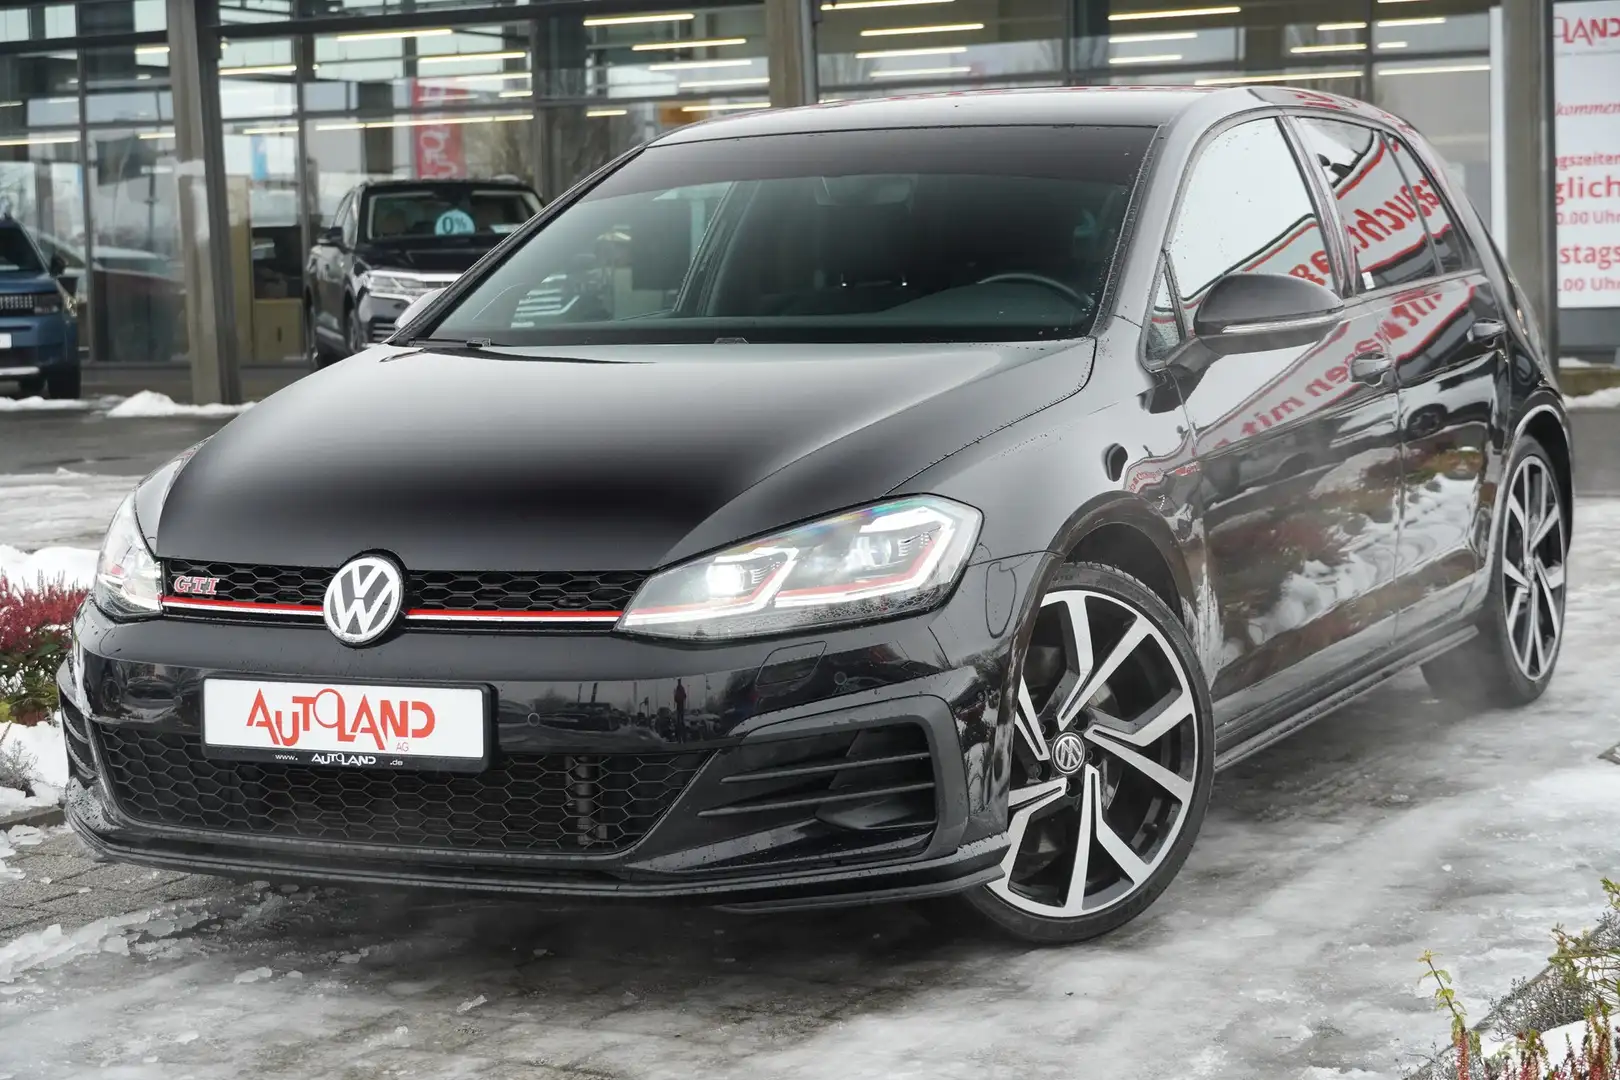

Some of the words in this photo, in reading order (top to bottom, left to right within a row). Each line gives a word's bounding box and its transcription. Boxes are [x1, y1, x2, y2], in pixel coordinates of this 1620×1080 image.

[174, 575, 220, 595] GTI
[246, 688, 435, 750] AUTOLAND
[396, 741, 409, 752] AG
[311, 752, 376, 766] AUTOLAND
